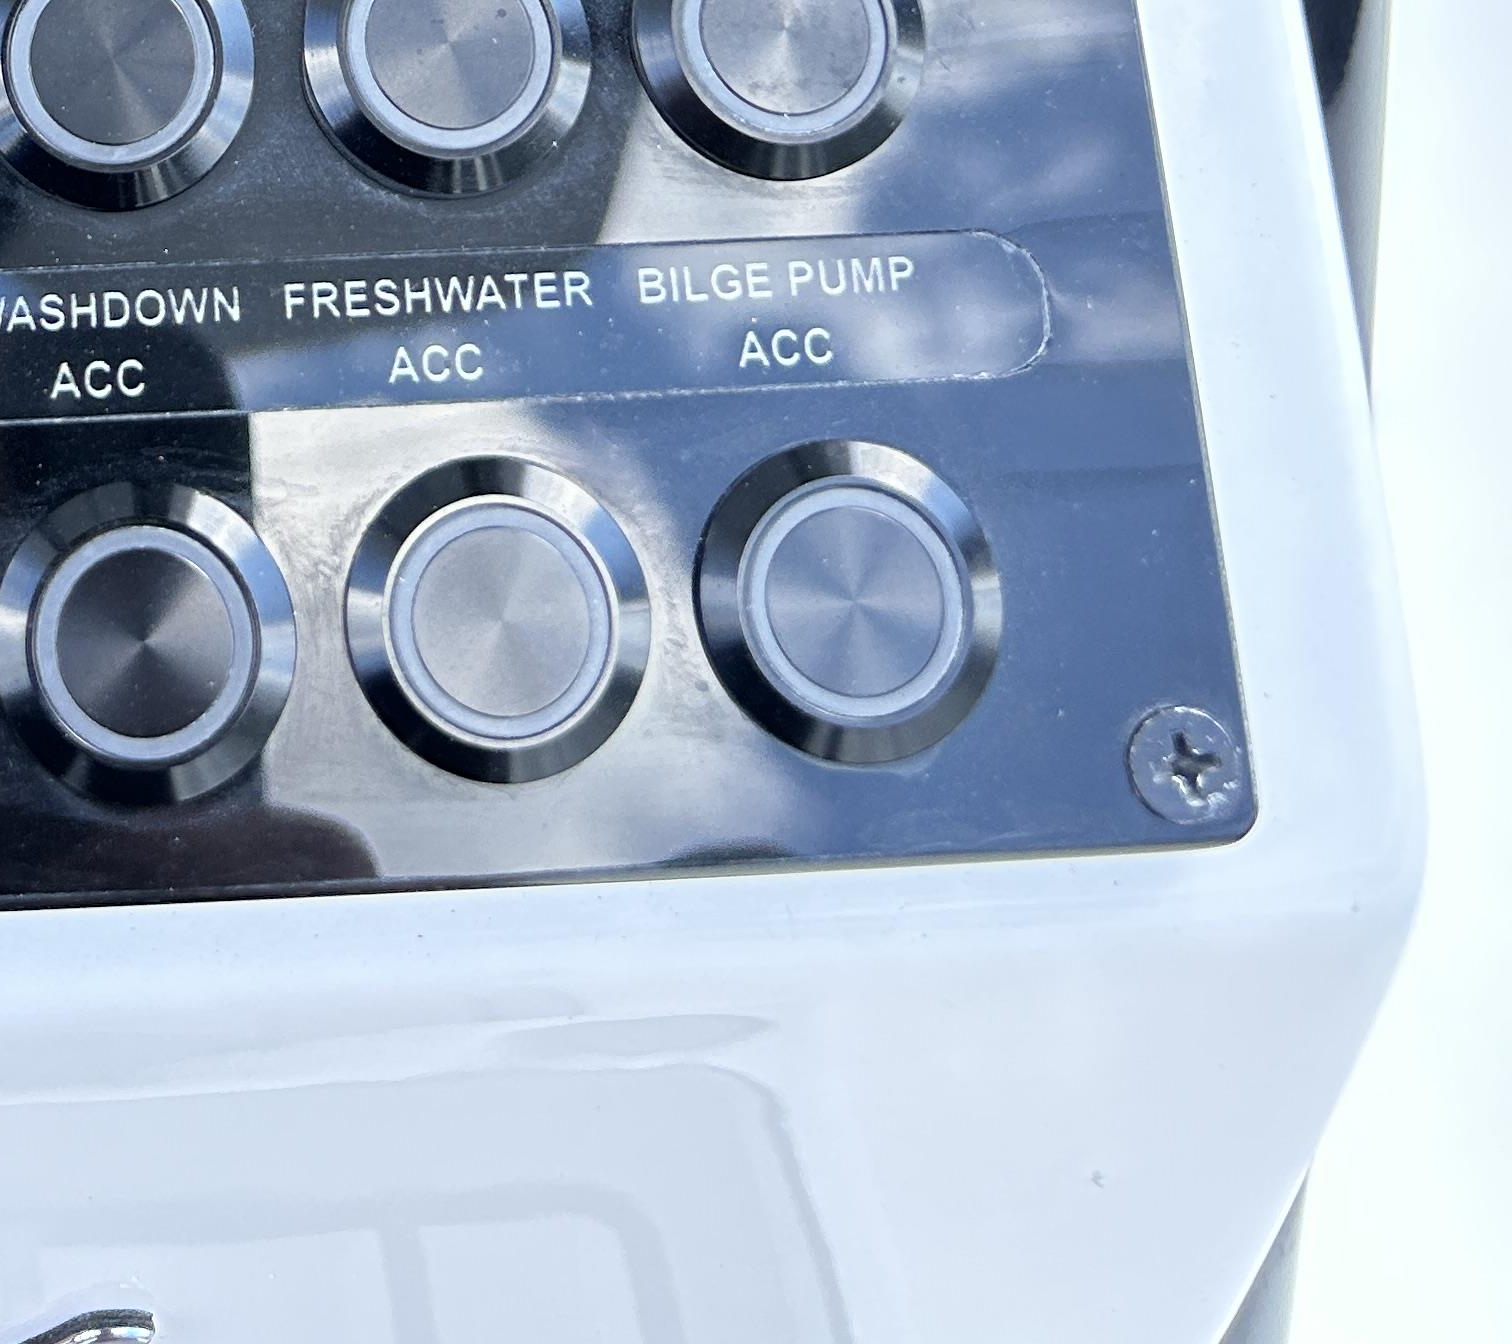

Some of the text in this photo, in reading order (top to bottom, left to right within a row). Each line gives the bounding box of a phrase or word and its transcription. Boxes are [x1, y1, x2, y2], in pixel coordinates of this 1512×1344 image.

[283, 271, 593, 320] FRESHWATER
[637, 256, 914, 305] BILGE PUMP
[388, 343, 484, 384] ACC
[739, 327, 833, 369] ACC
[49, 358, 145, 400] ACC
